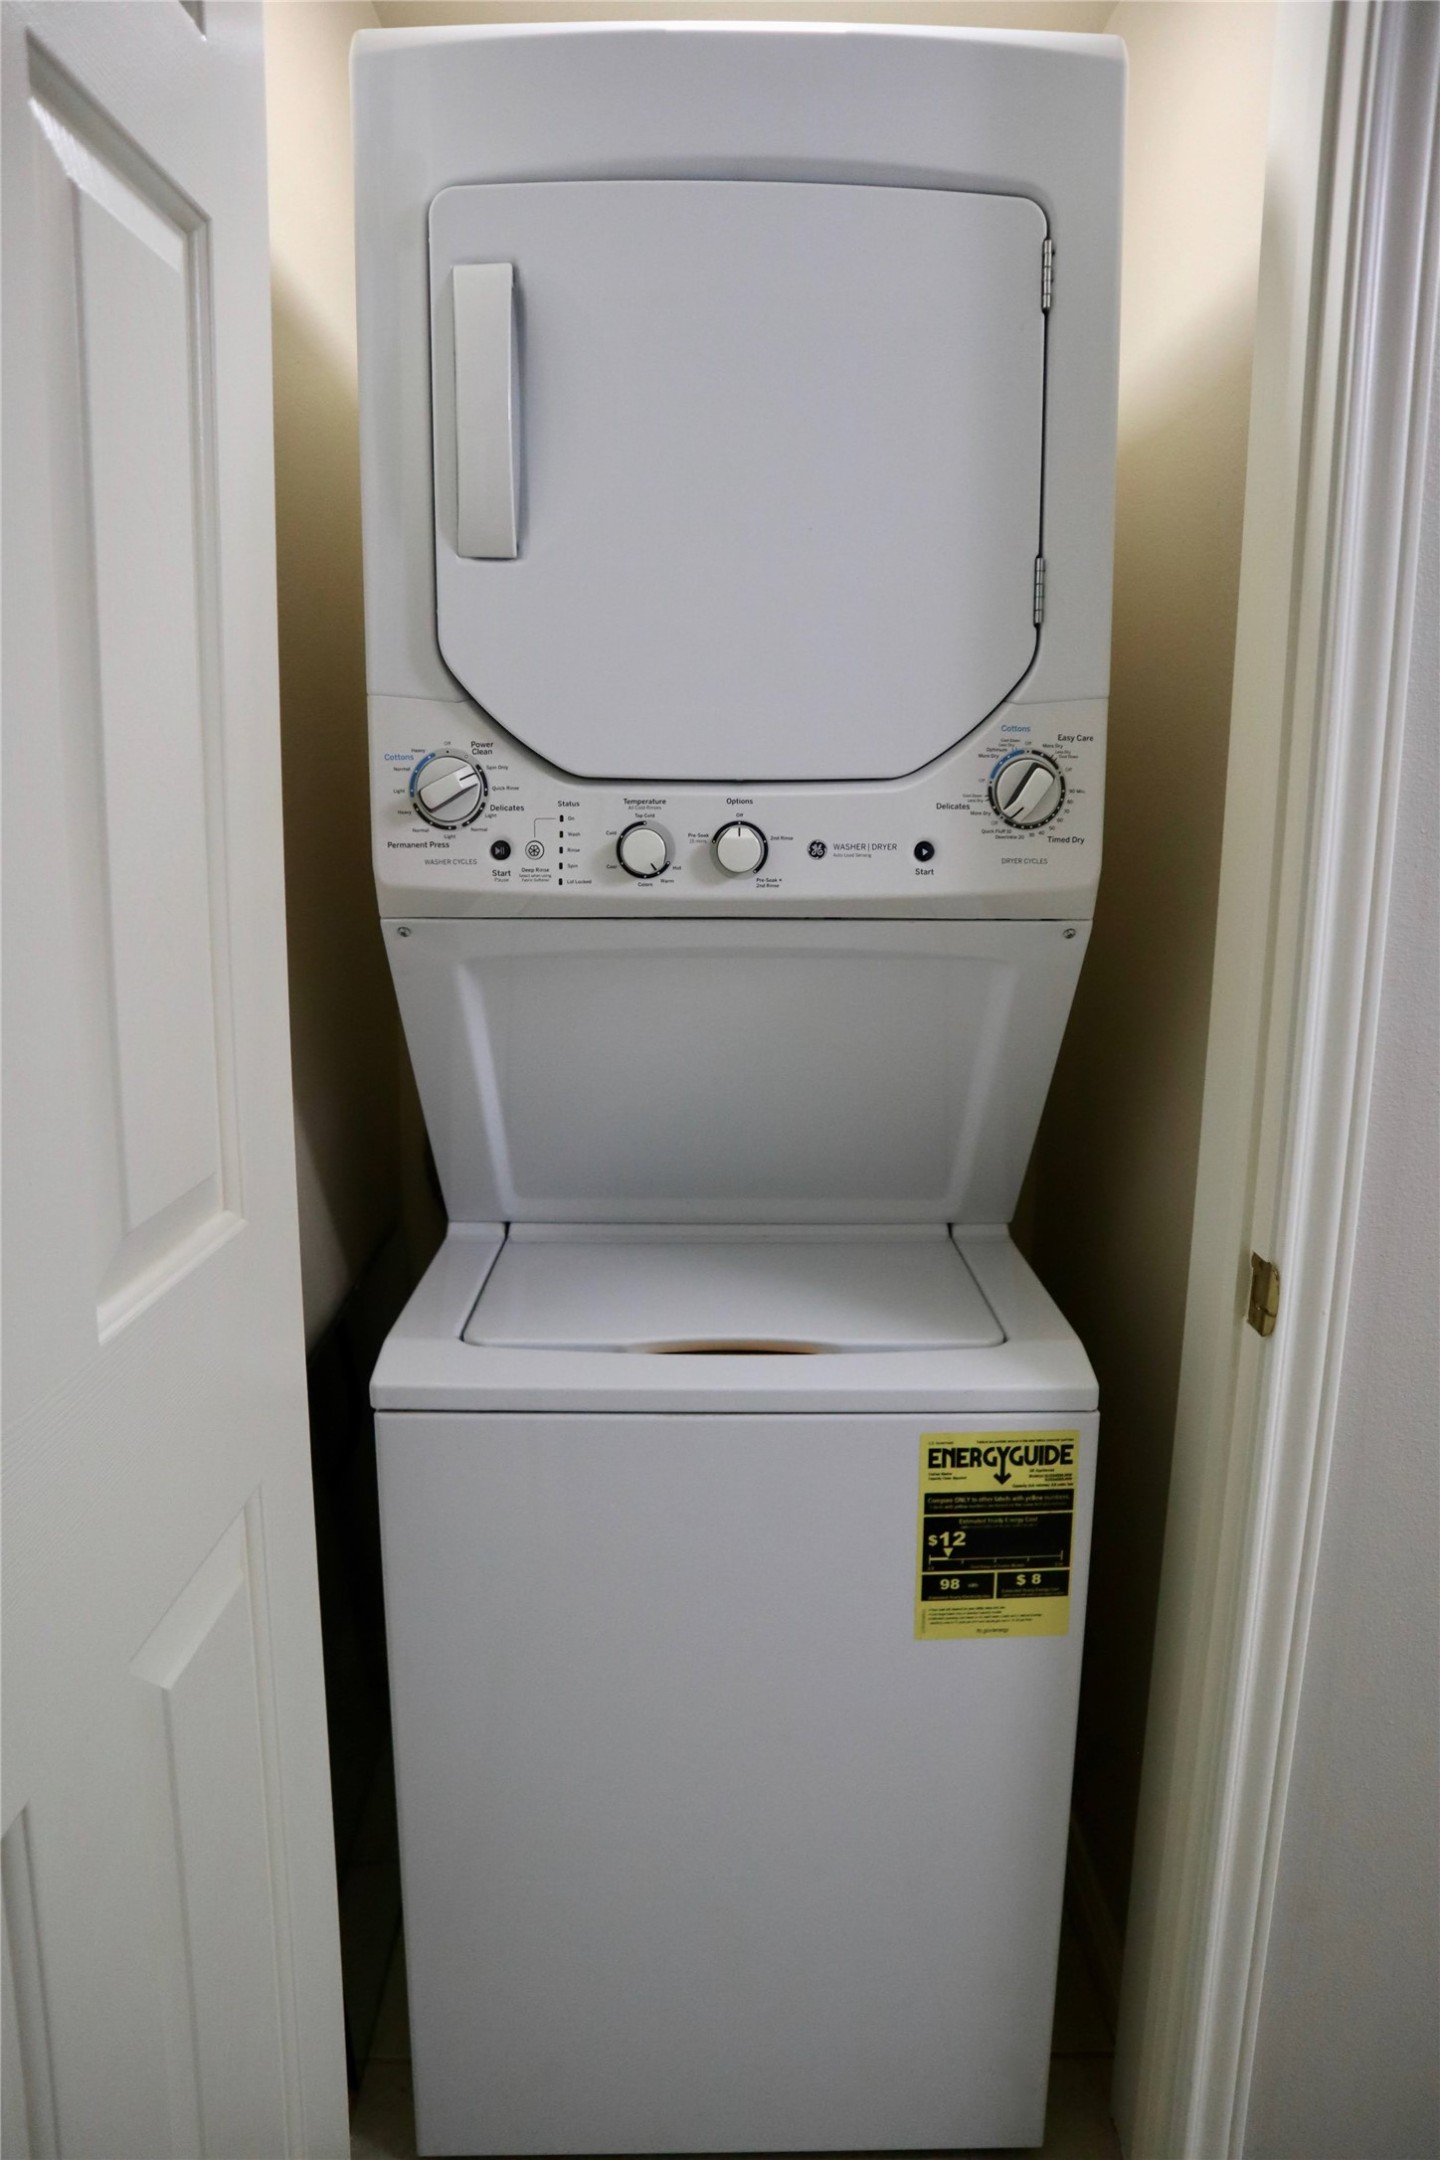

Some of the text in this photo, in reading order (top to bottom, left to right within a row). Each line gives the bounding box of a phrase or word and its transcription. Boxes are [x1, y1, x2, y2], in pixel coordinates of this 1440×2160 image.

[1001, 725, 1031, 733] Cottons
[1058, 734, 1094, 743] Easy Care
[470, 741, 494, 749] Power
[384, 753, 415, 761] Cottons
[623, 798, 666, 806] Temperature
[726, 798, 753, 806] Options
[936, 802, 970, 810] Delicates
[490, 804, 524, 812] Delicates
[1072, 836, 1085, 845] Dry
[387, 841, 428, 849] Permanent
[492, 869, 511, 877] Start
[915, 868, 934, 876] Start
[928, 1443, 1074, 1470] ENERGYGUIDE
[928, 1531, 966, 1546] $12
[1031, 1573, 1042, 1584] 8
[940, 1578, 960, 1590] 98
